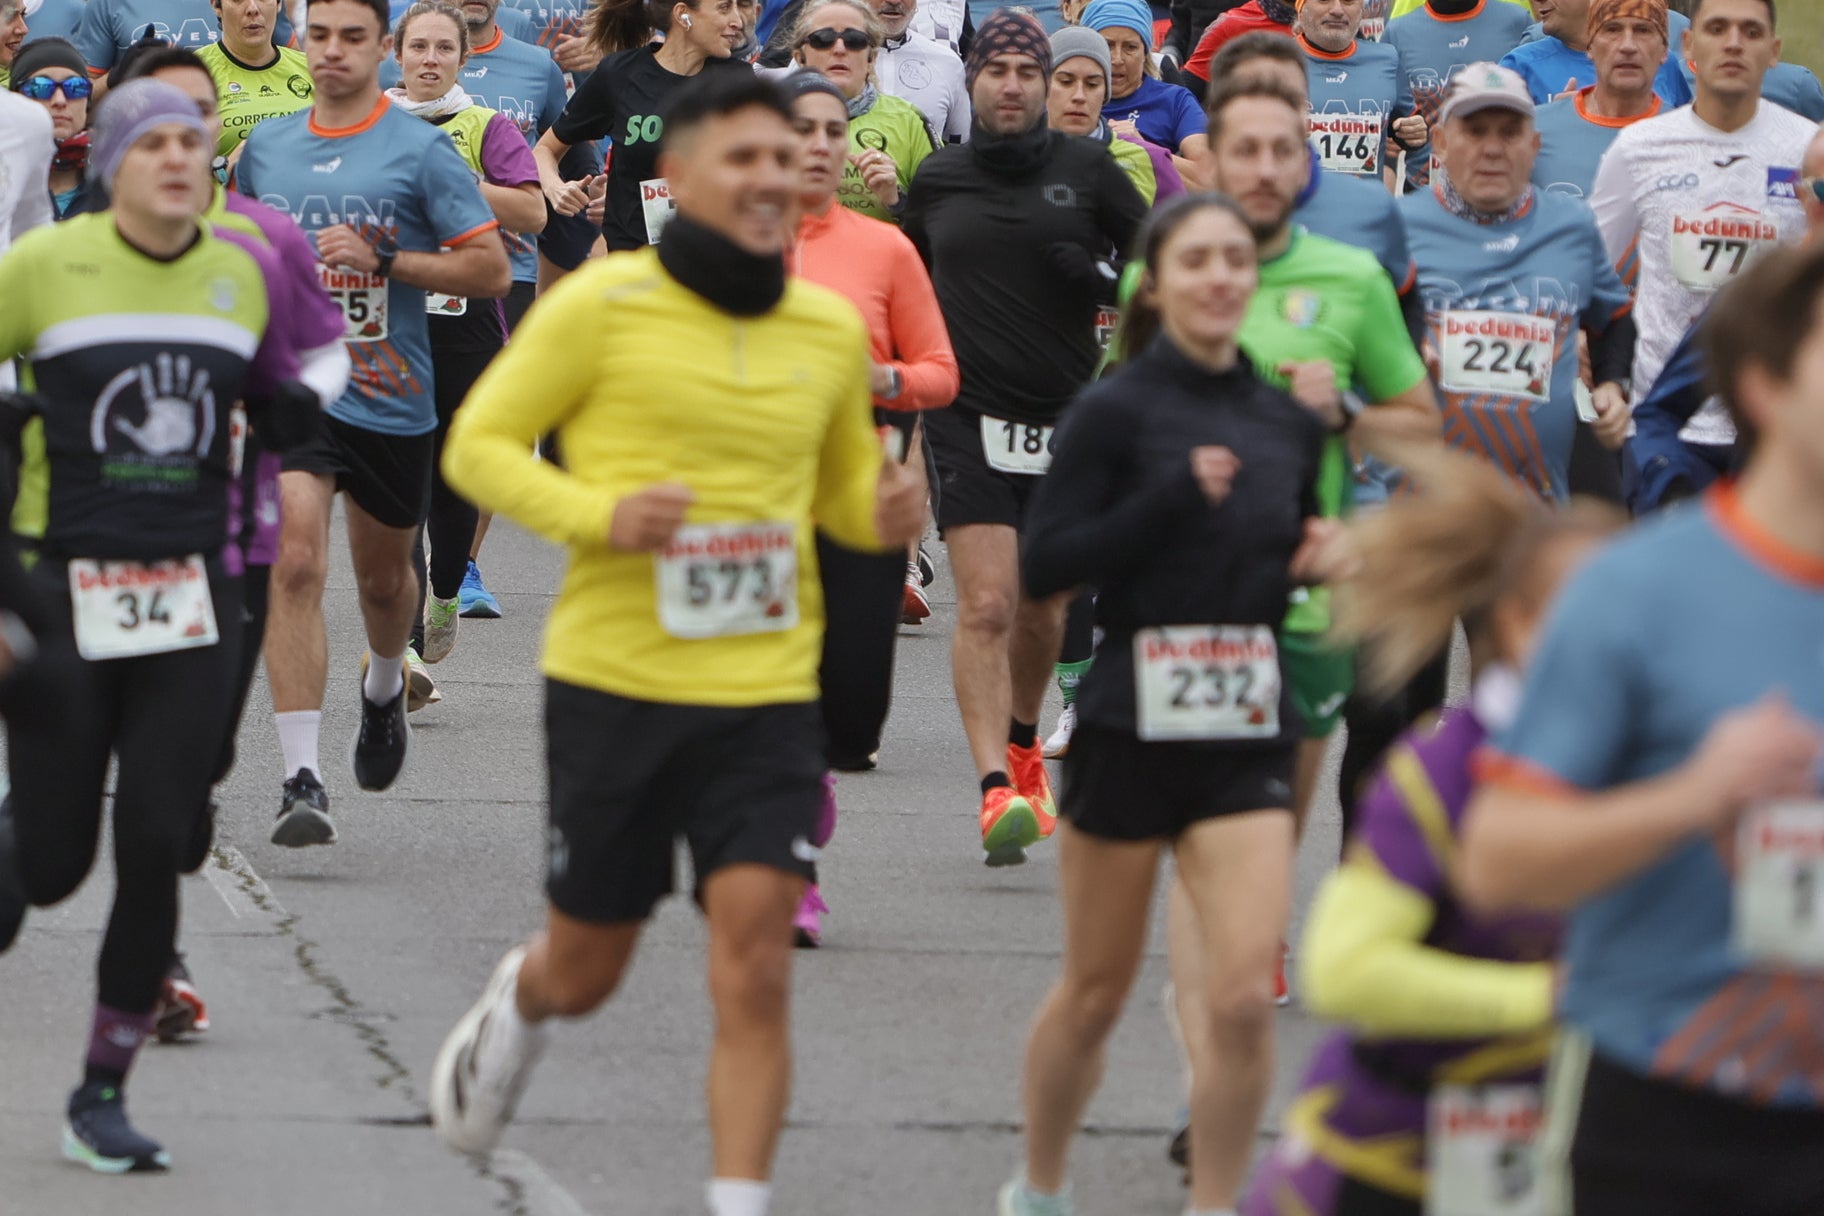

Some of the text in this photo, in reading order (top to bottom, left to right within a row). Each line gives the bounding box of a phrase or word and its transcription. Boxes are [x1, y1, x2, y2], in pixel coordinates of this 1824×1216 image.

[1320, 134, 1369, 160] 146
[1673, 215, 1777, 240] bedunia
[1447, 317, 1549, 343] bedunia
[1463, 339, 1535, 377] 224
[687, 557, 772, 607] 573
[117, 590, 171, 630] 34
[1170, 666, 1255, 710] 232
